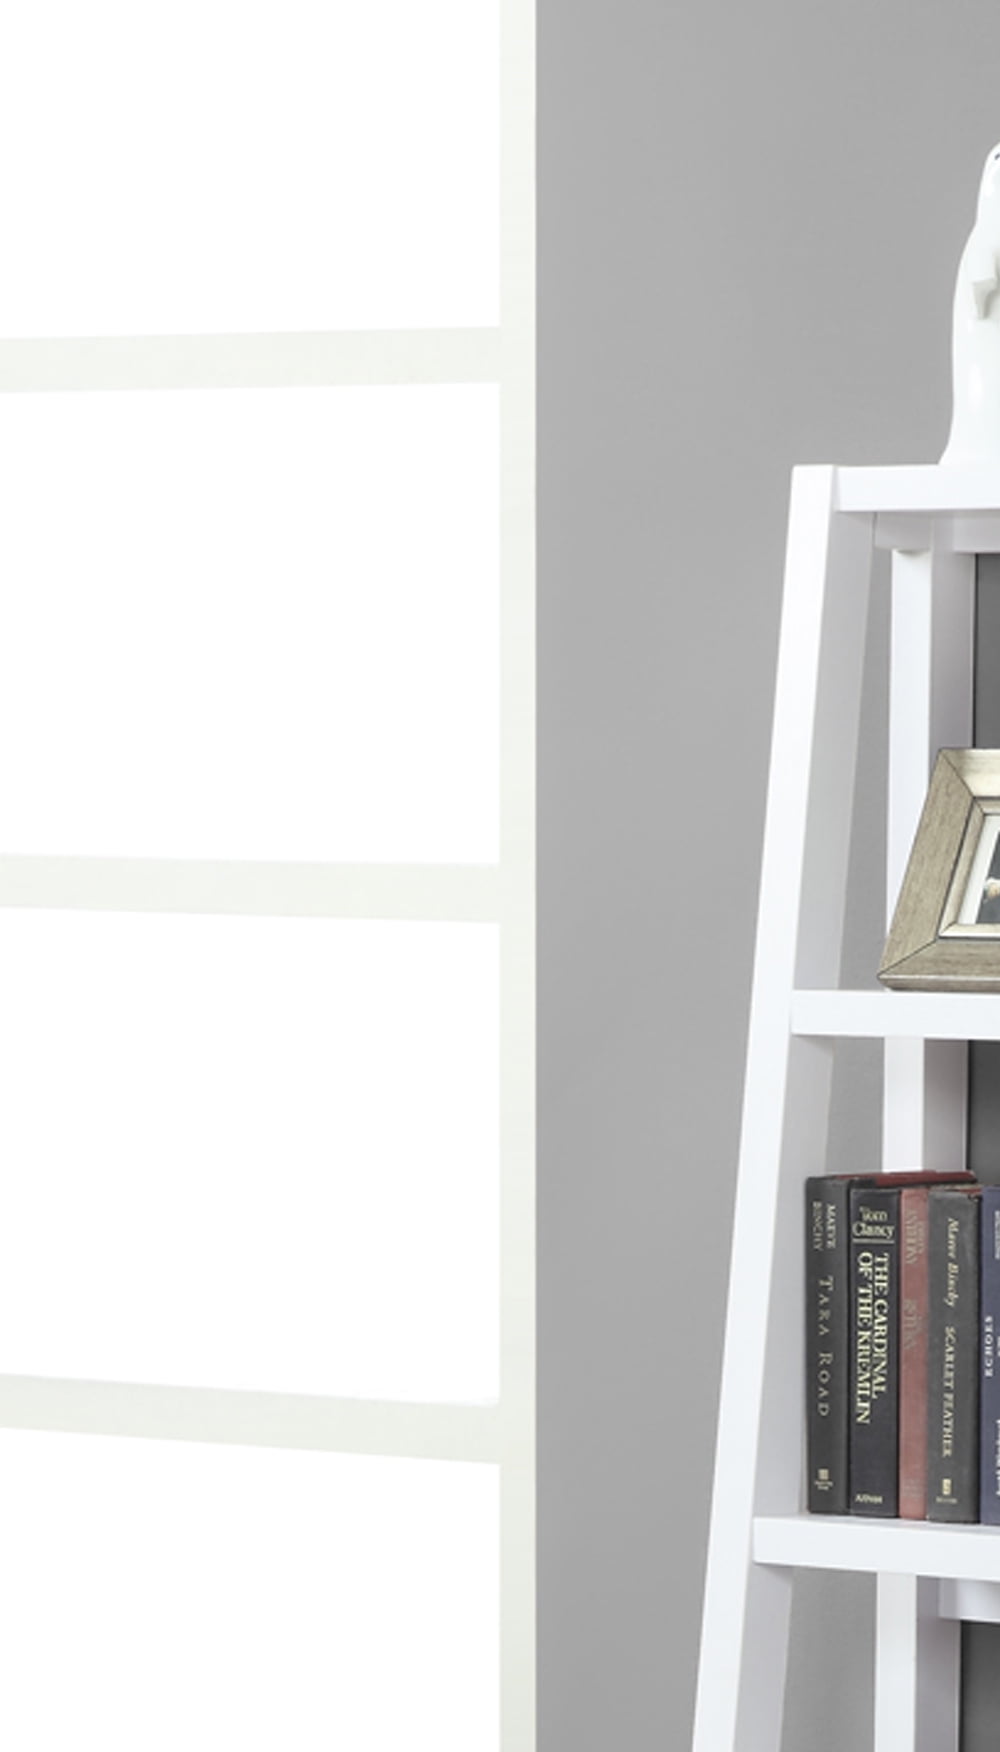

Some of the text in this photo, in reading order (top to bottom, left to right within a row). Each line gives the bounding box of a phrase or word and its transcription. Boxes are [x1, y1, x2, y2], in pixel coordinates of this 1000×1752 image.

[852, 1222, 894, 1239] Clancy
[817, 1275, 834, 1416] TARA ROAD
[856, 1252, 873, 1424] OF THE KREMLIN
[872, 1252, 889, 1399] THE CARDINAL
[942, 1326, 957, 1458] SCARLET FEATHER
[984, 1316, 994, 1376] ECHOES
